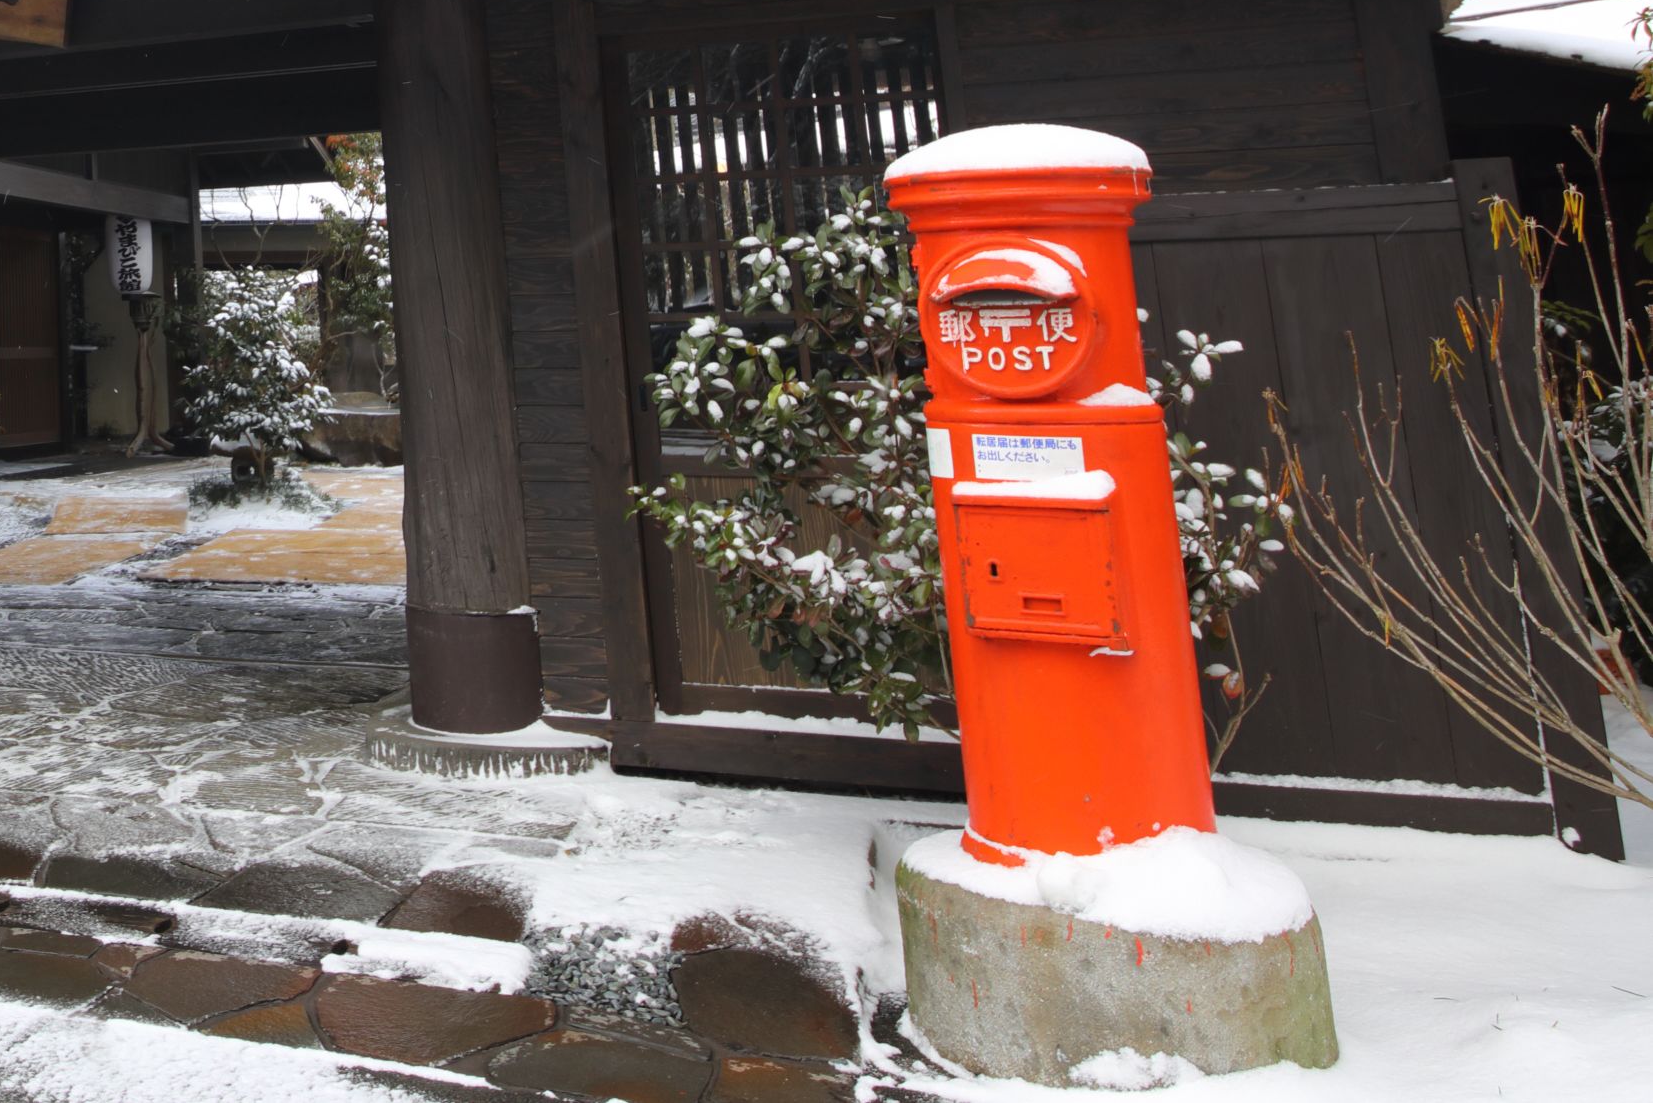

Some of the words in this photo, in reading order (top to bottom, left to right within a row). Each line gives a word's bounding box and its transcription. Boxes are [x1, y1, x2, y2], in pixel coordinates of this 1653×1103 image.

[962, 346, 1055, 372] POST
[976, 436, 1077, 450] 転居届は郵便局にも
[977, 450, 1051, 464] お出しください。
